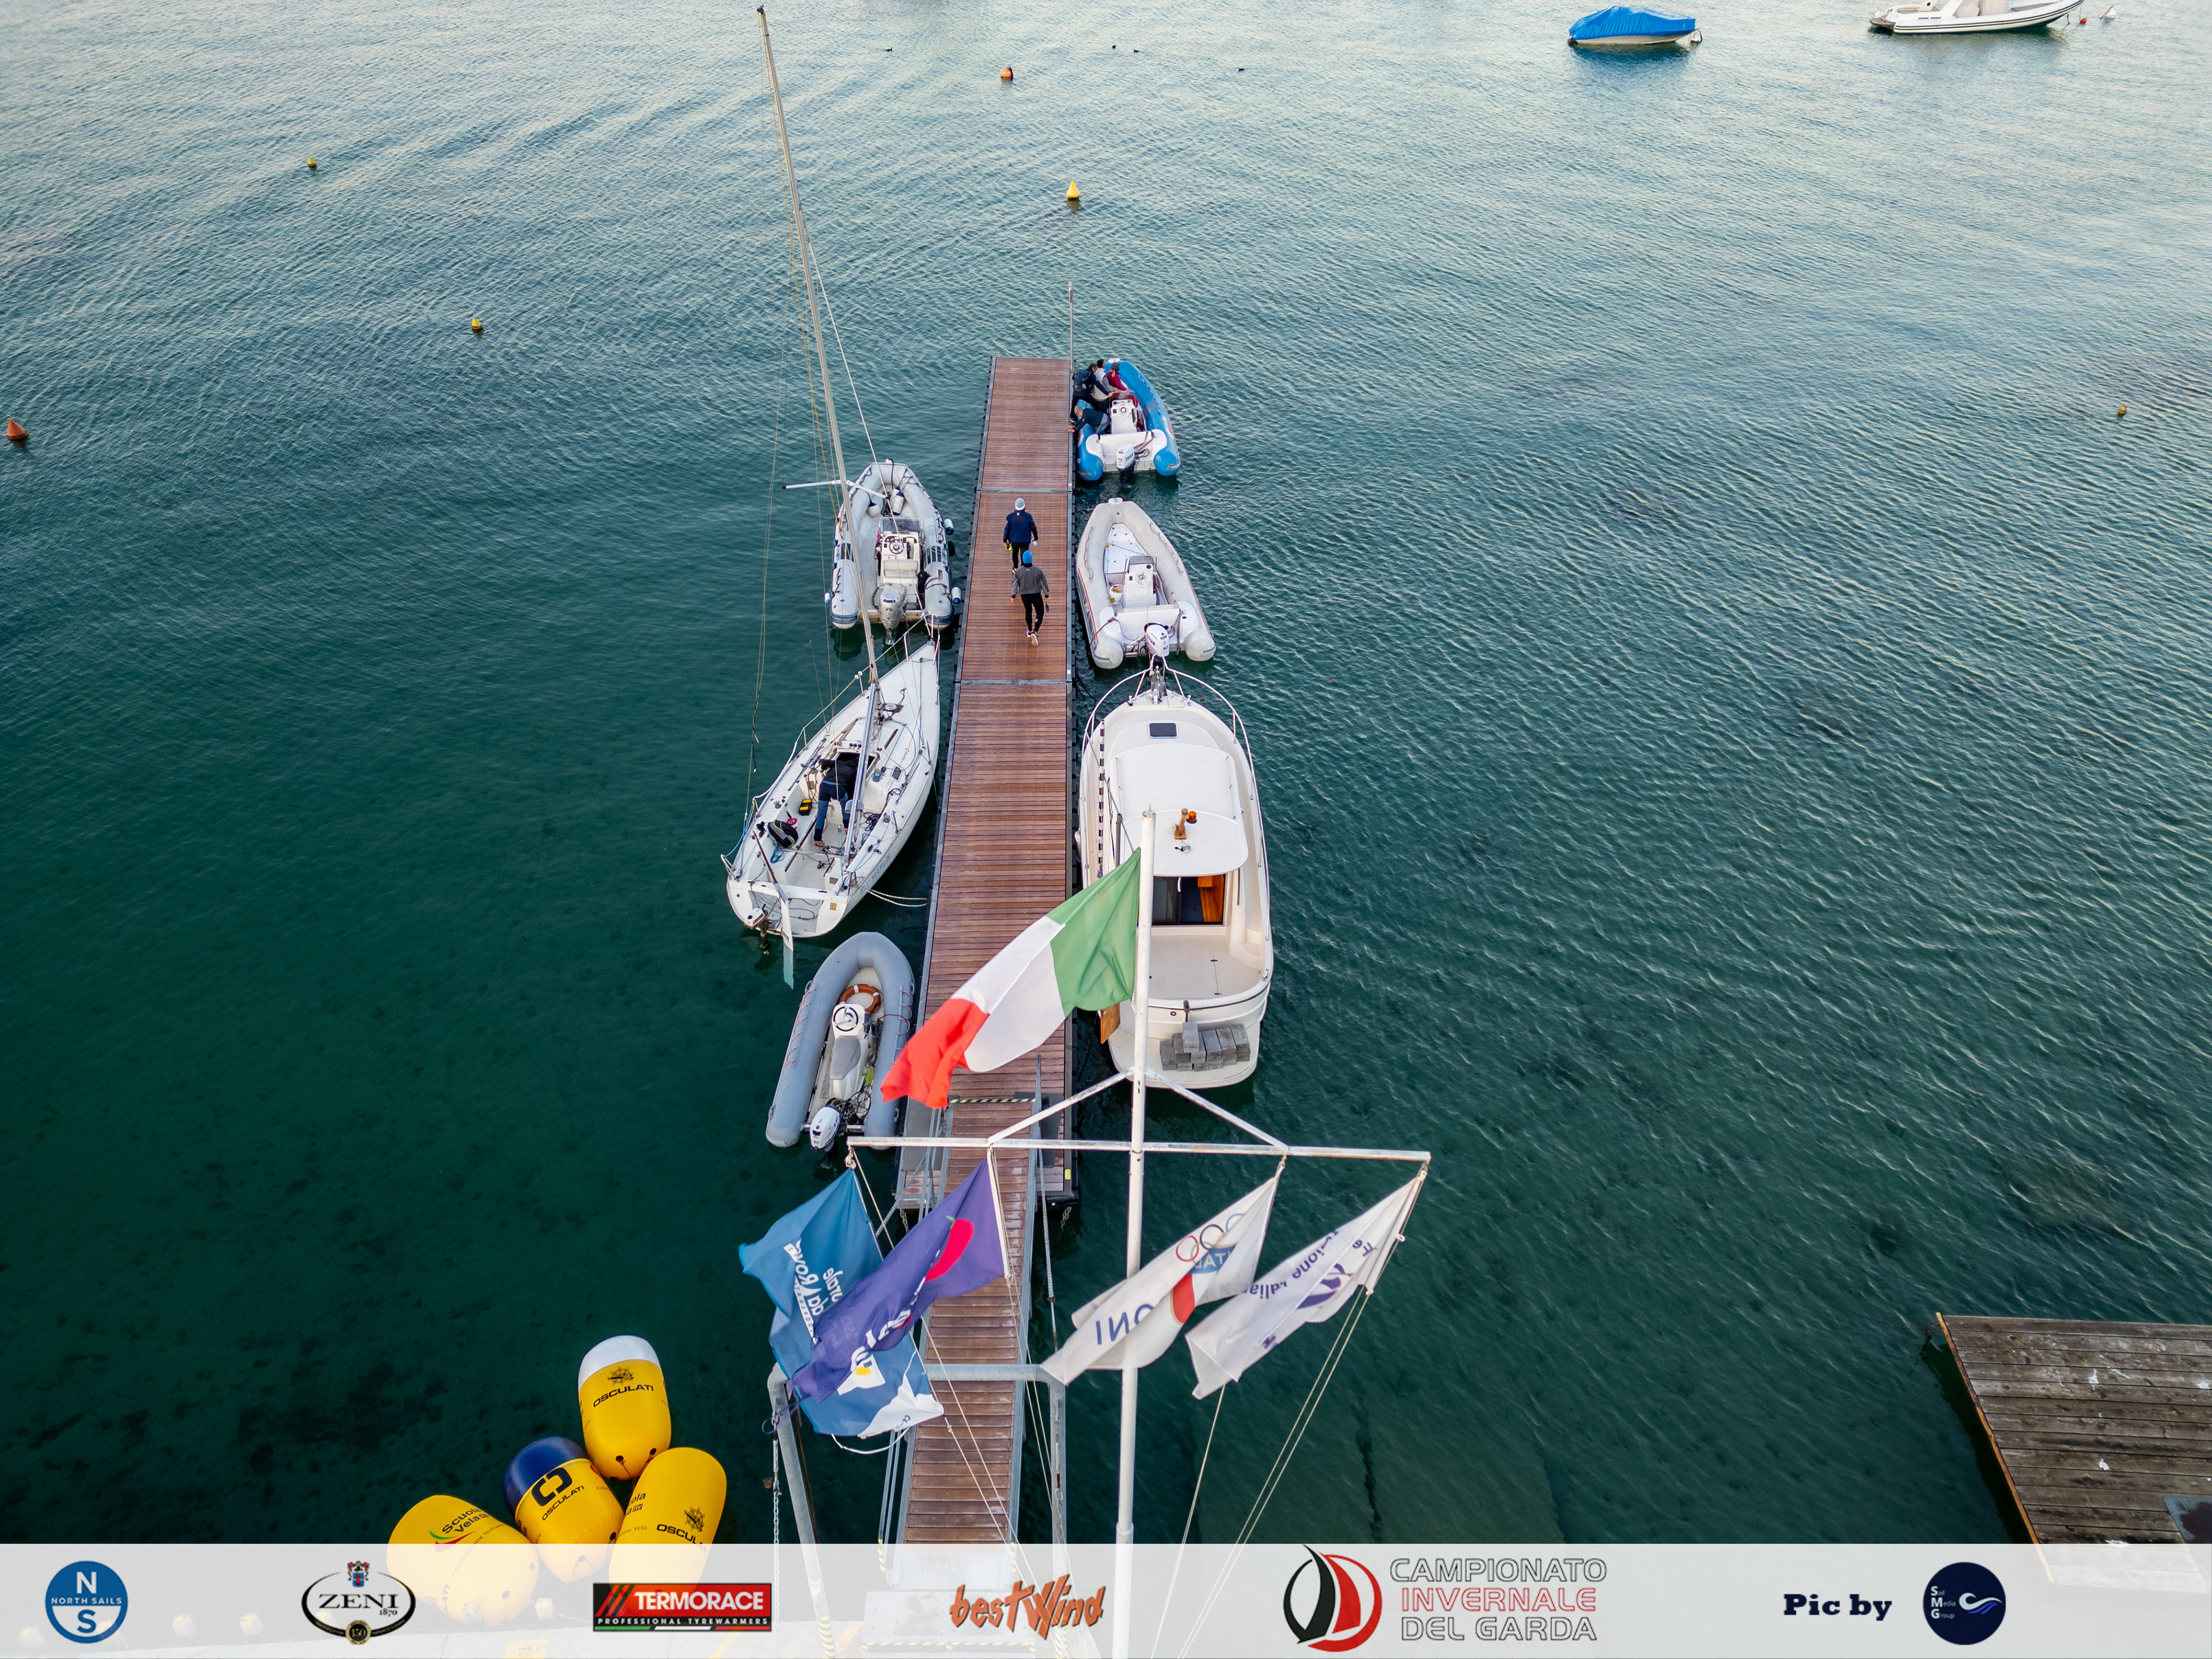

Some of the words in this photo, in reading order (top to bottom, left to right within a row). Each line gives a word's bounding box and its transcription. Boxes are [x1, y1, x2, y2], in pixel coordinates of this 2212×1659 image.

[593, 1384, 654, 1407] OSCULATI
[541, 1485, 585, 1521] OSCULATI
[442, 1508, 482, 1534] Scuola
[454, 1515, 480, 1532] Vela
